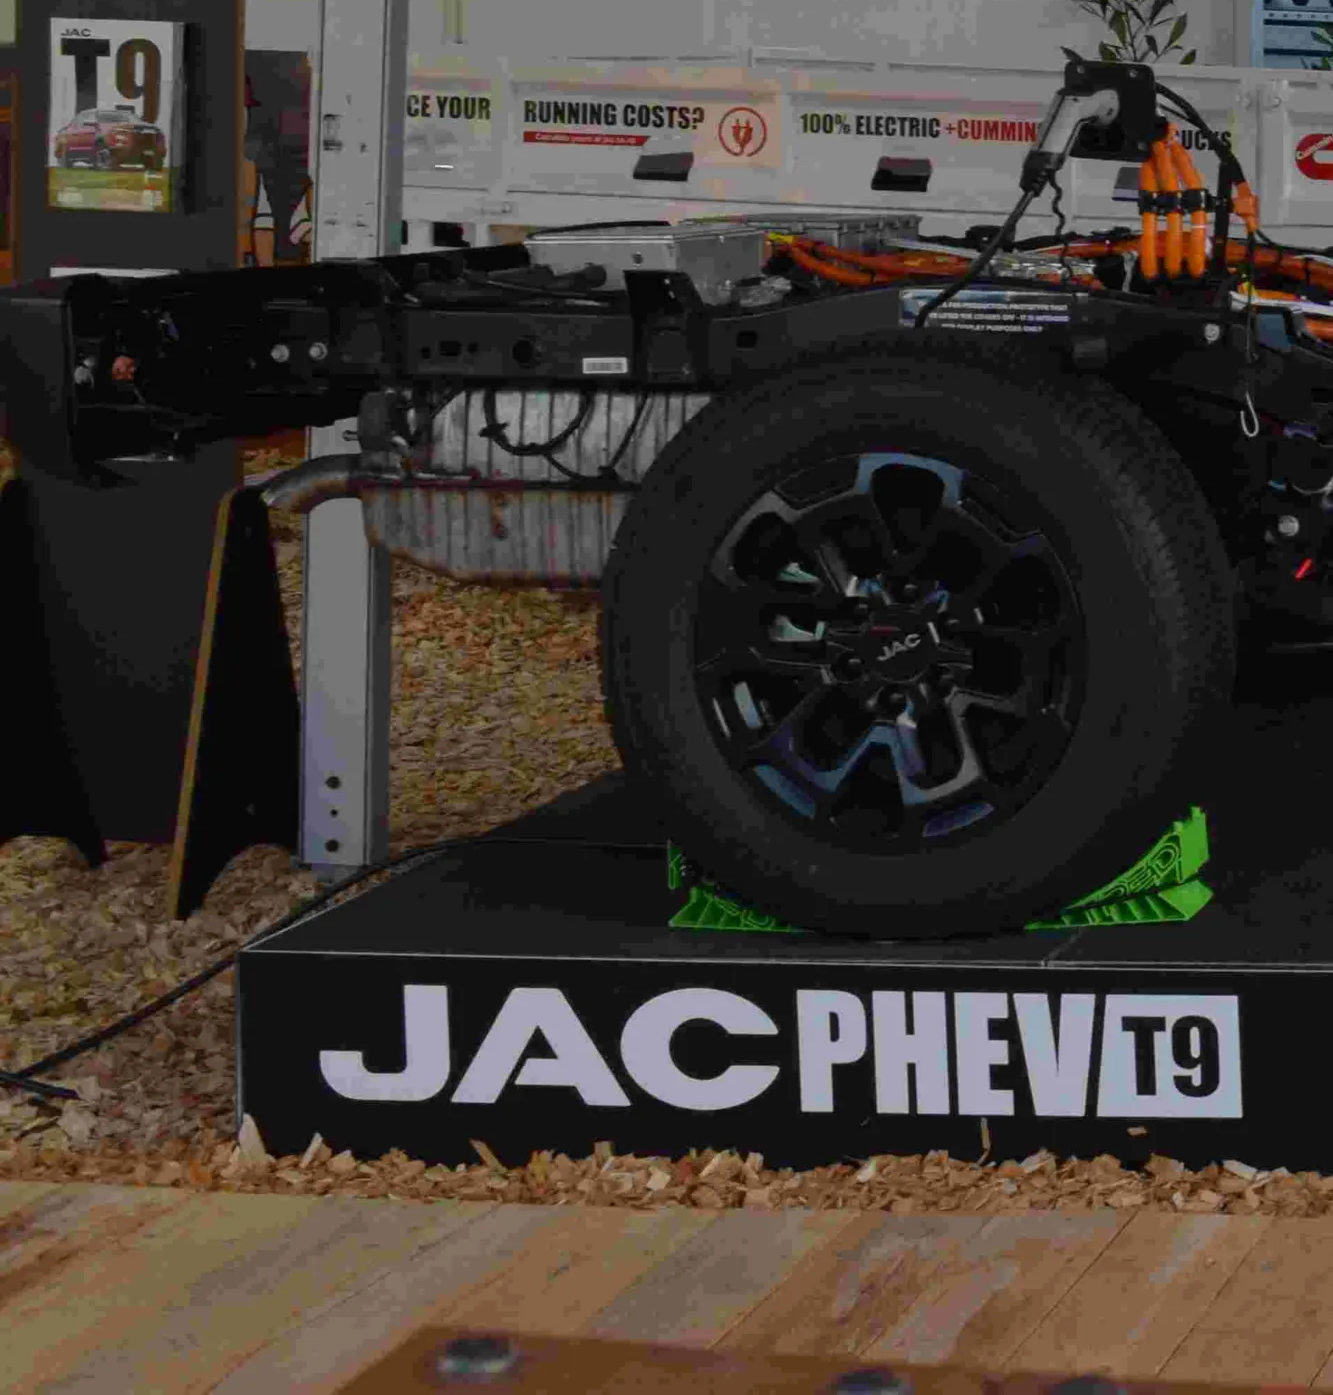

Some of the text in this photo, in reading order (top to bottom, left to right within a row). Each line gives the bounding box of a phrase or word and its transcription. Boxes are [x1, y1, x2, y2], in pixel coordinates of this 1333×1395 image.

[60, 28, 92, 38] JAC
[60, 37, 162, 126] T9
[435, 95, 491, 120] YOUR
[523, 100, 705, 130] RUNNING COSTS?
[799, 113, 1041, 144] 100% ELECTRIC +CUMMIN
[876, 633, 922, 662] JAC
[318, 983, 1221, 1117] JAC PHEV T9
